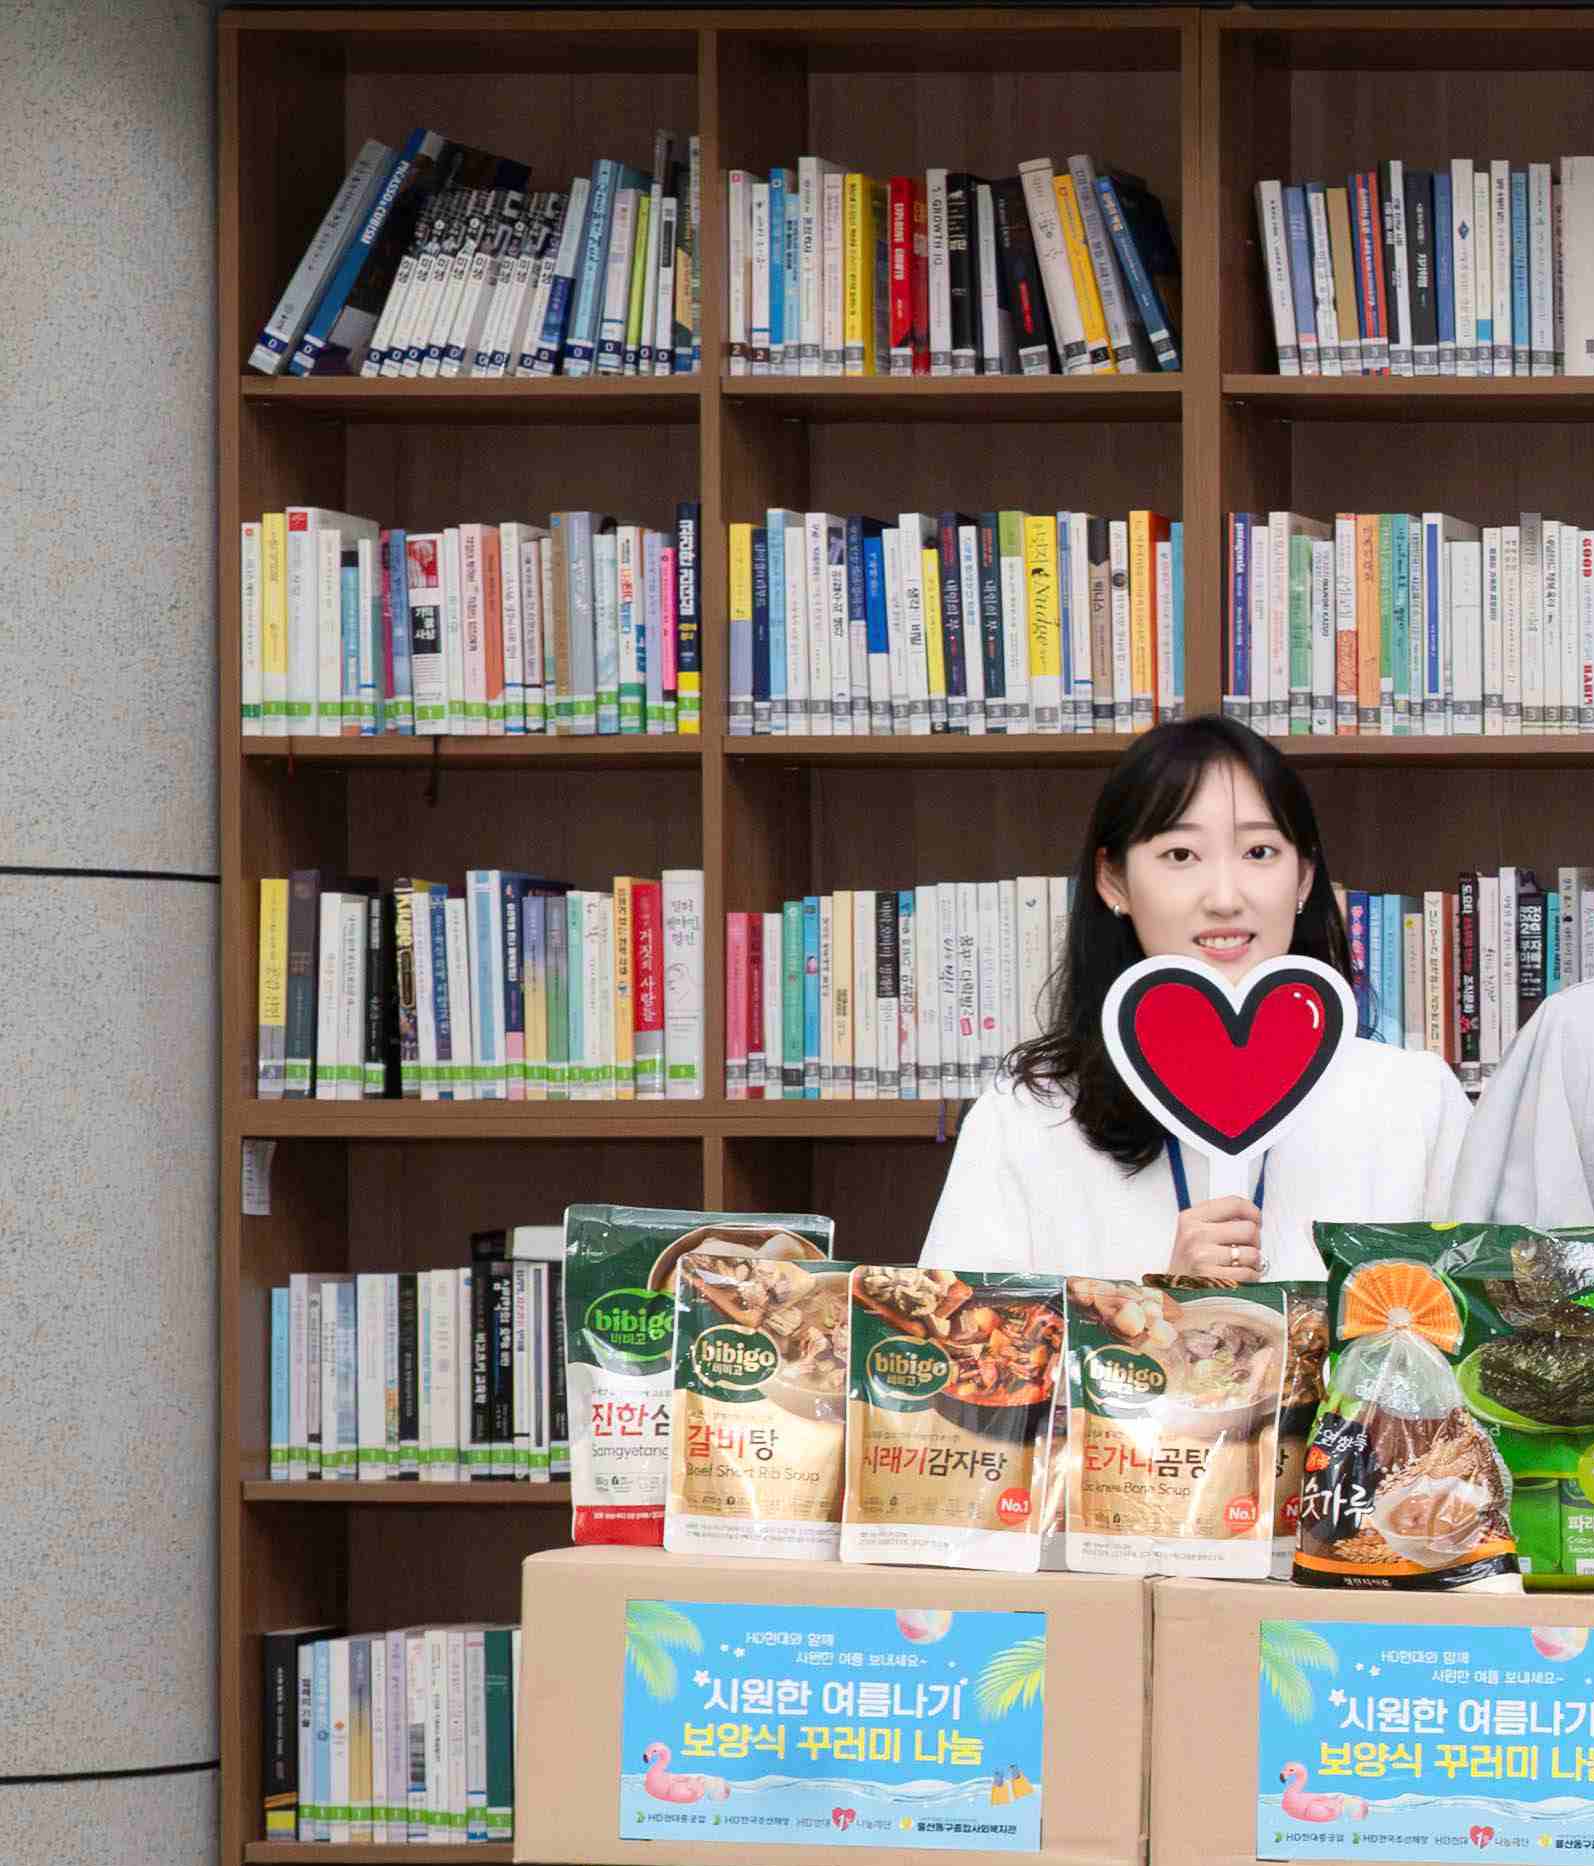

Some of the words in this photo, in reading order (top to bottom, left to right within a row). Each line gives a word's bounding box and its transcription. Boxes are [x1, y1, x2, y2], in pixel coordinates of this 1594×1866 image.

[1582, 537, 1593, 577] GOOD
[701, 1341, 776, 1373] bibigo
[873, 1351, 950, 1385] bibigo
[1089, 1358, 1165, 1393] bibigo
[686, 1423, 780, 1462] 갈비탕
[783, 1466, 821, 1482] Soup
[862, 1446, 1008, 1482] 시래기감자탕
[1082, 1446, 1210, 1479] 도가니곰탕
[1001, 1497, 1031, 1513] No.1
[1227, 1506, 1258, 1522] No.1
[703, 1676, 812, 1716] 시원한
[821, 1680, 961, 1720] 여름나기
[681, 1721, 785, 1760] 보양식
[796, 1725, 901, 1763] 꾸러미
[913, 1728, 984, 1766] 나눔
